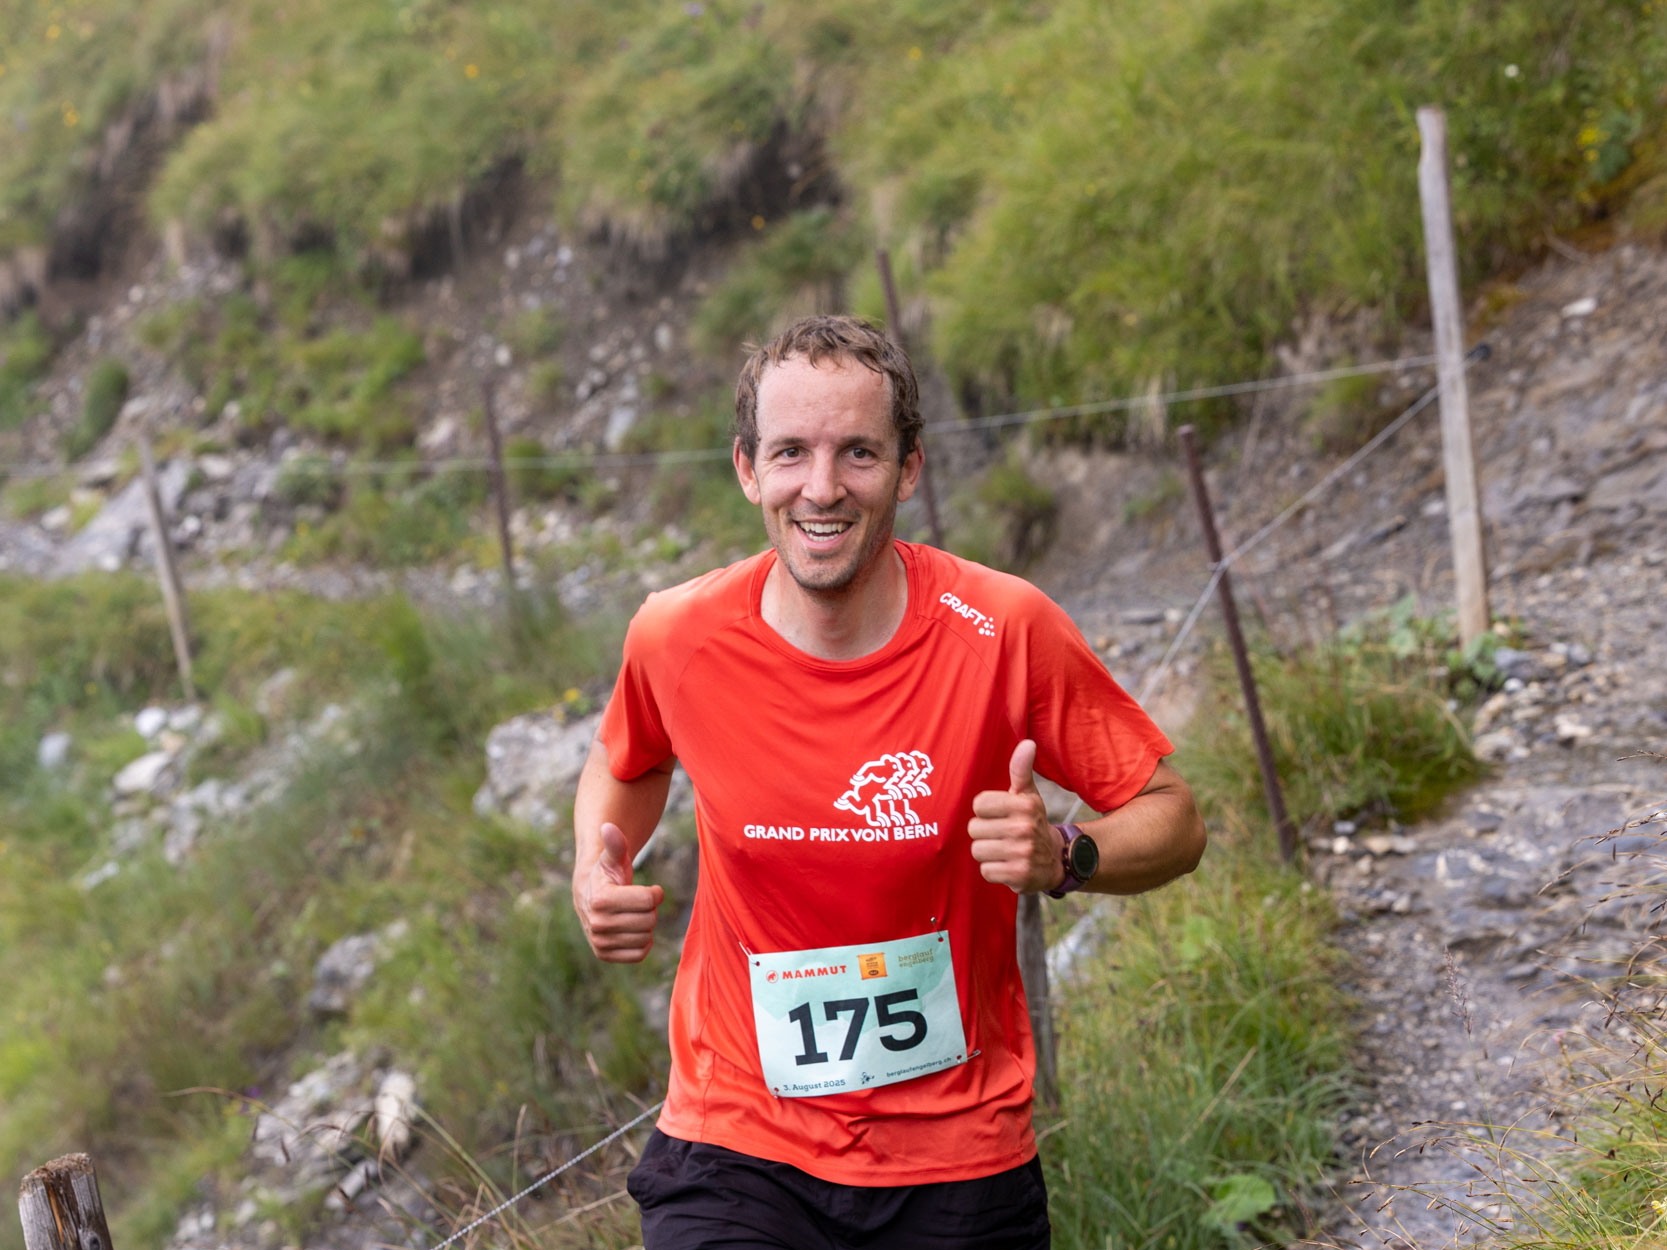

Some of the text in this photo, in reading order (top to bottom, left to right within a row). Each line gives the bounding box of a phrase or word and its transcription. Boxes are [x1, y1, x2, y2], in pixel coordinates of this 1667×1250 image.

[939, 592, 986, 626] CRAFT
[743, 821, 939, 842] GRAND PRIX VON BERN
[897, 948, 934, 962] berglauf
[781, 964, 847, 980] MAMMUT
[788, 988, 928, 1066] 175
[783, 1078, 847, 1092] 3. August 2025
